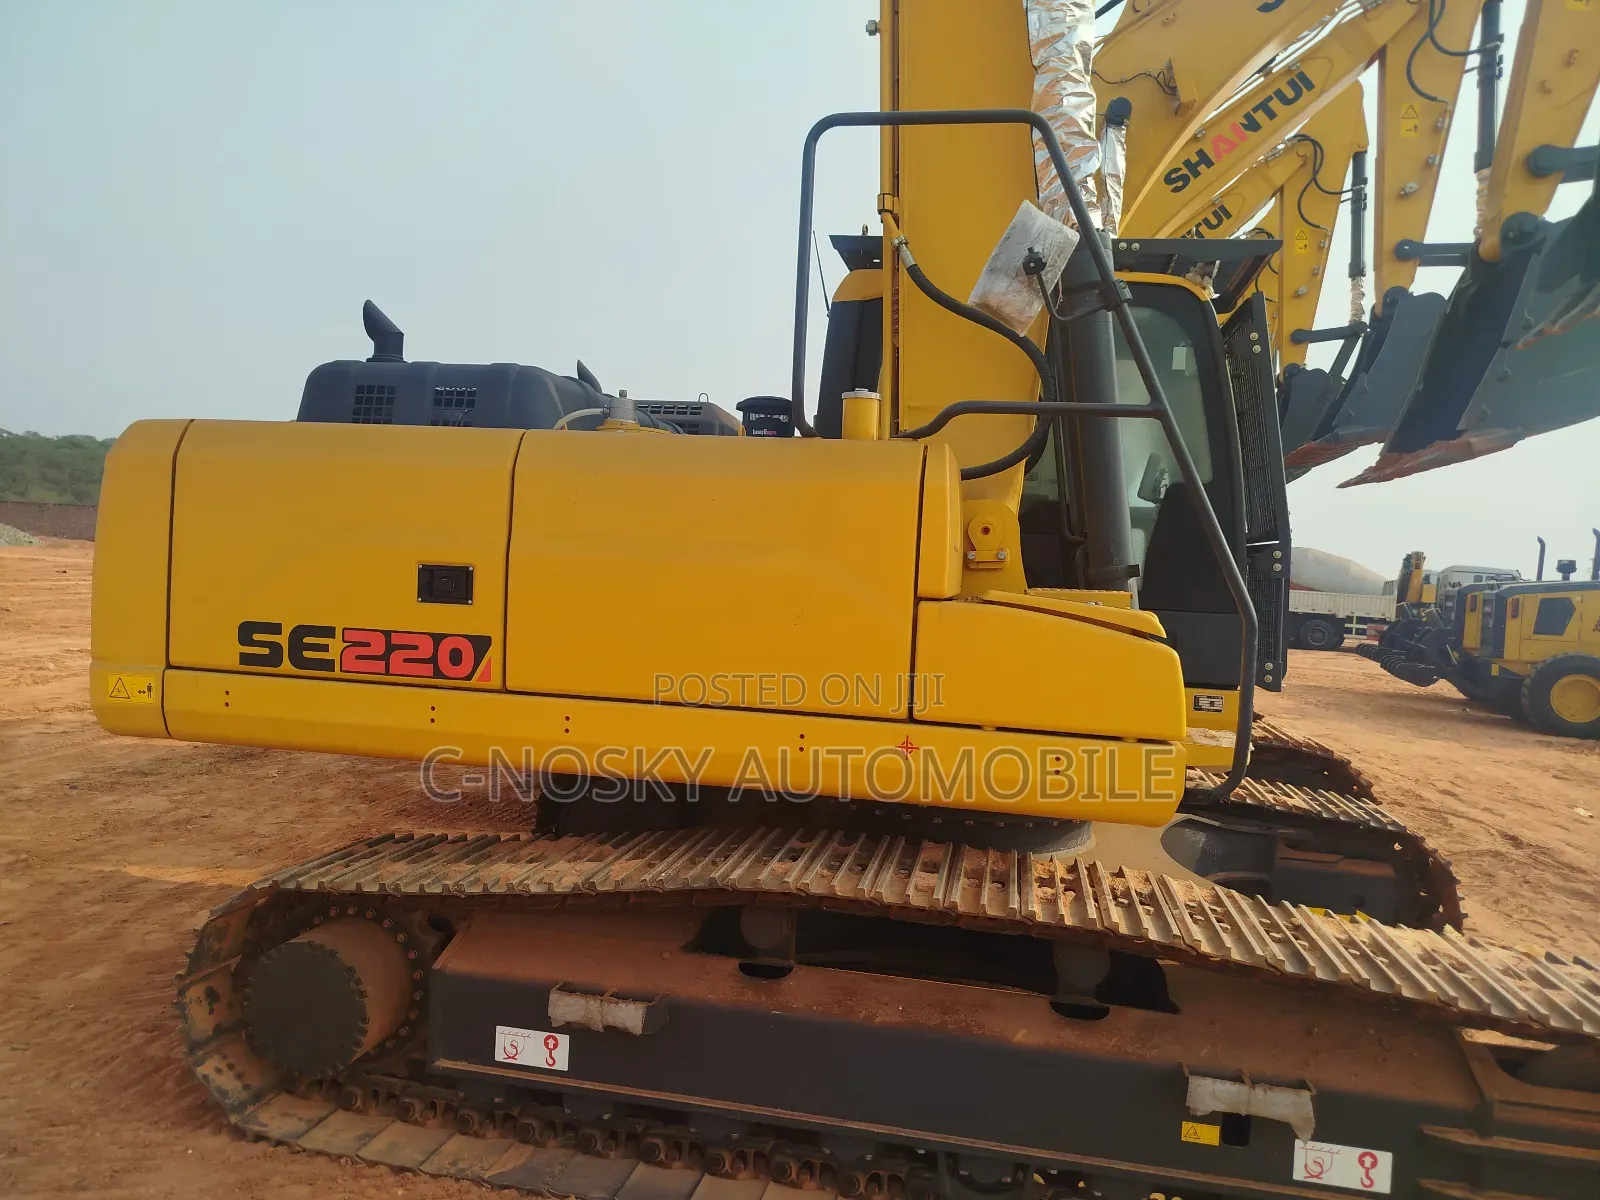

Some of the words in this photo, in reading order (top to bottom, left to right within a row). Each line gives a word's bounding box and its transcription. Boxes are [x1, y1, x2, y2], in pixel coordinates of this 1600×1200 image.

[1163, 70, 1316, 194] SHANTUI
[1180, 204, 1233, 239] TUI
[237, 620, 476, 680] SE220
